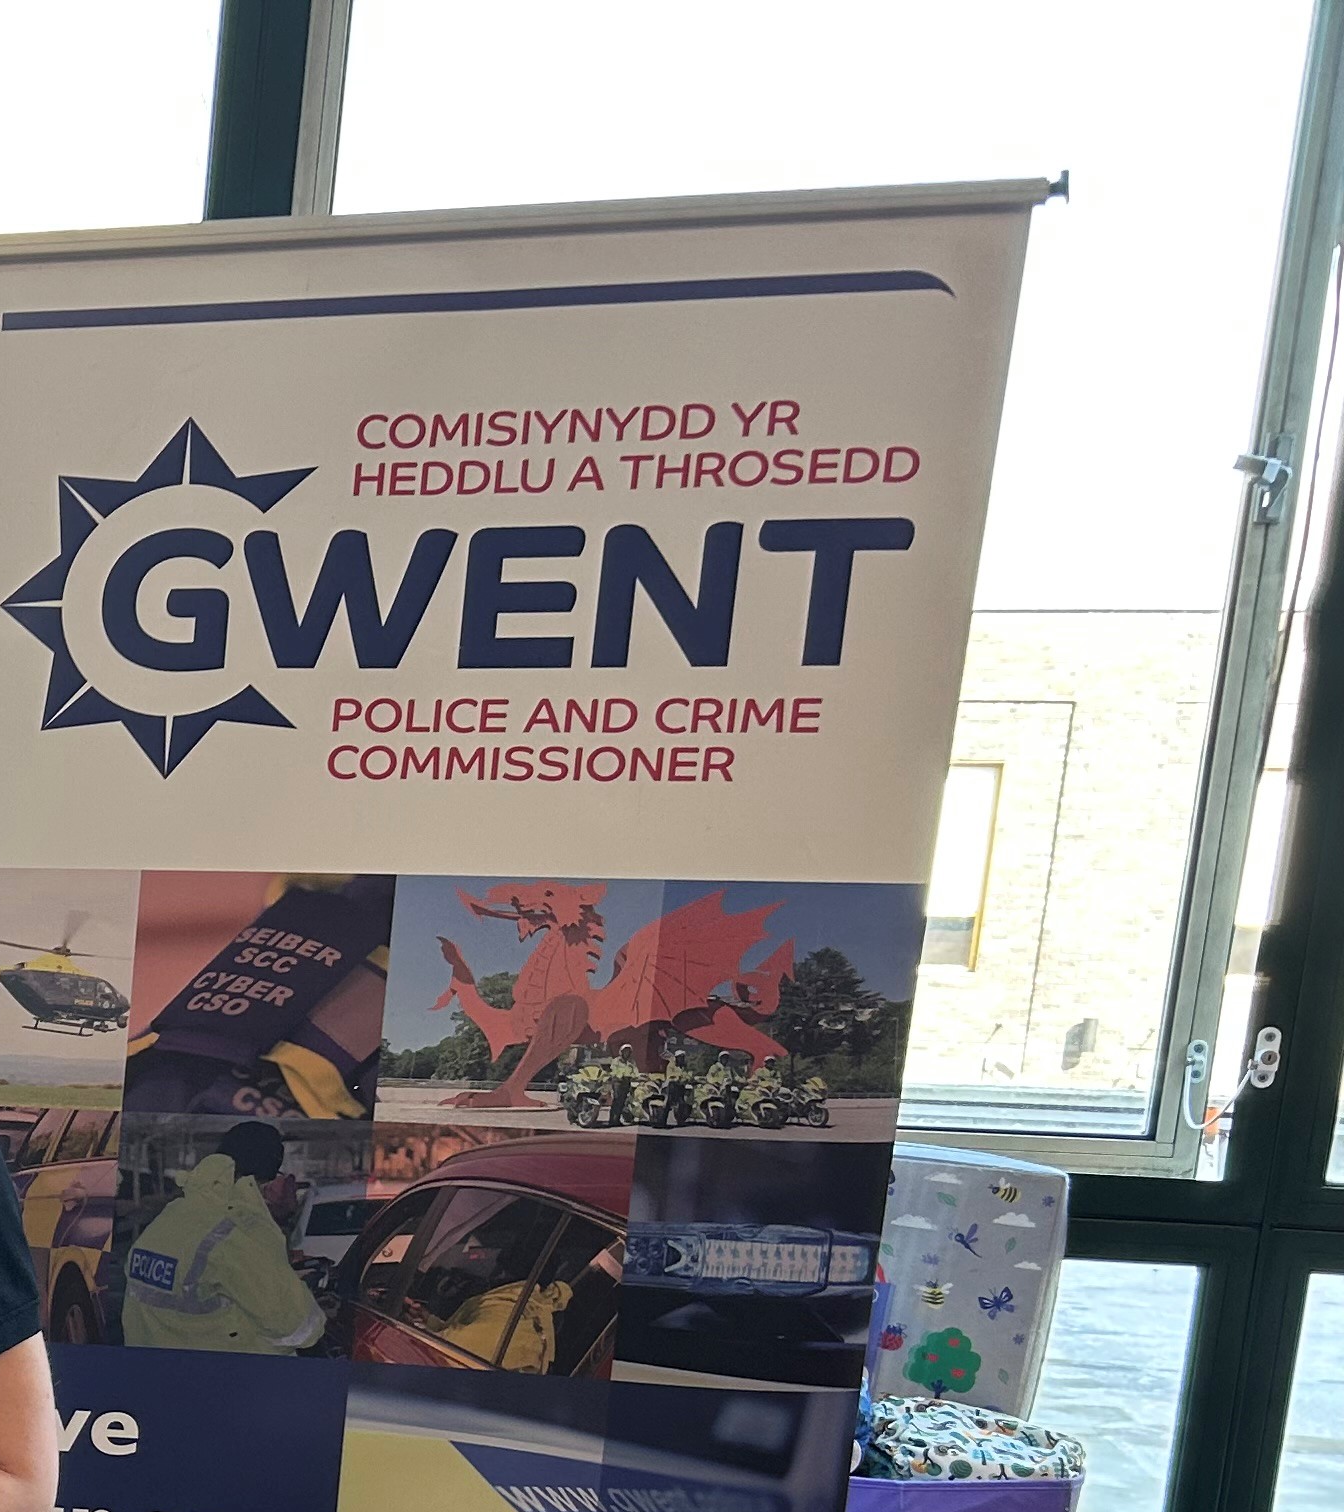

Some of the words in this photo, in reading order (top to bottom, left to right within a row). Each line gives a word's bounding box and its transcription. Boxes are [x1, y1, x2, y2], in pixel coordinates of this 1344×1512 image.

[356, 401, 716, 452] COMISIYNYDD
[732, 399, 800, 436] YR
[352, 449, 556, 498] HEDDLU
[567, 453, 606, 493] A
[618, 446, 921, 491] THROSEDD
[101, 516, 916, 673] GWENT
[331, 696, 509, 734] POLICE
[523, 696, 640, 735] AND
[655, 696, 822, 735] CRIME
[326, 744, 735, 783] COMMISSIONER
[234, 947, 298, 973] SCC
[235, 927, 342, 967] SEIBER
[187, 992, 250, 1015] CSO
[193, 972, 294, 1007] CYBER
